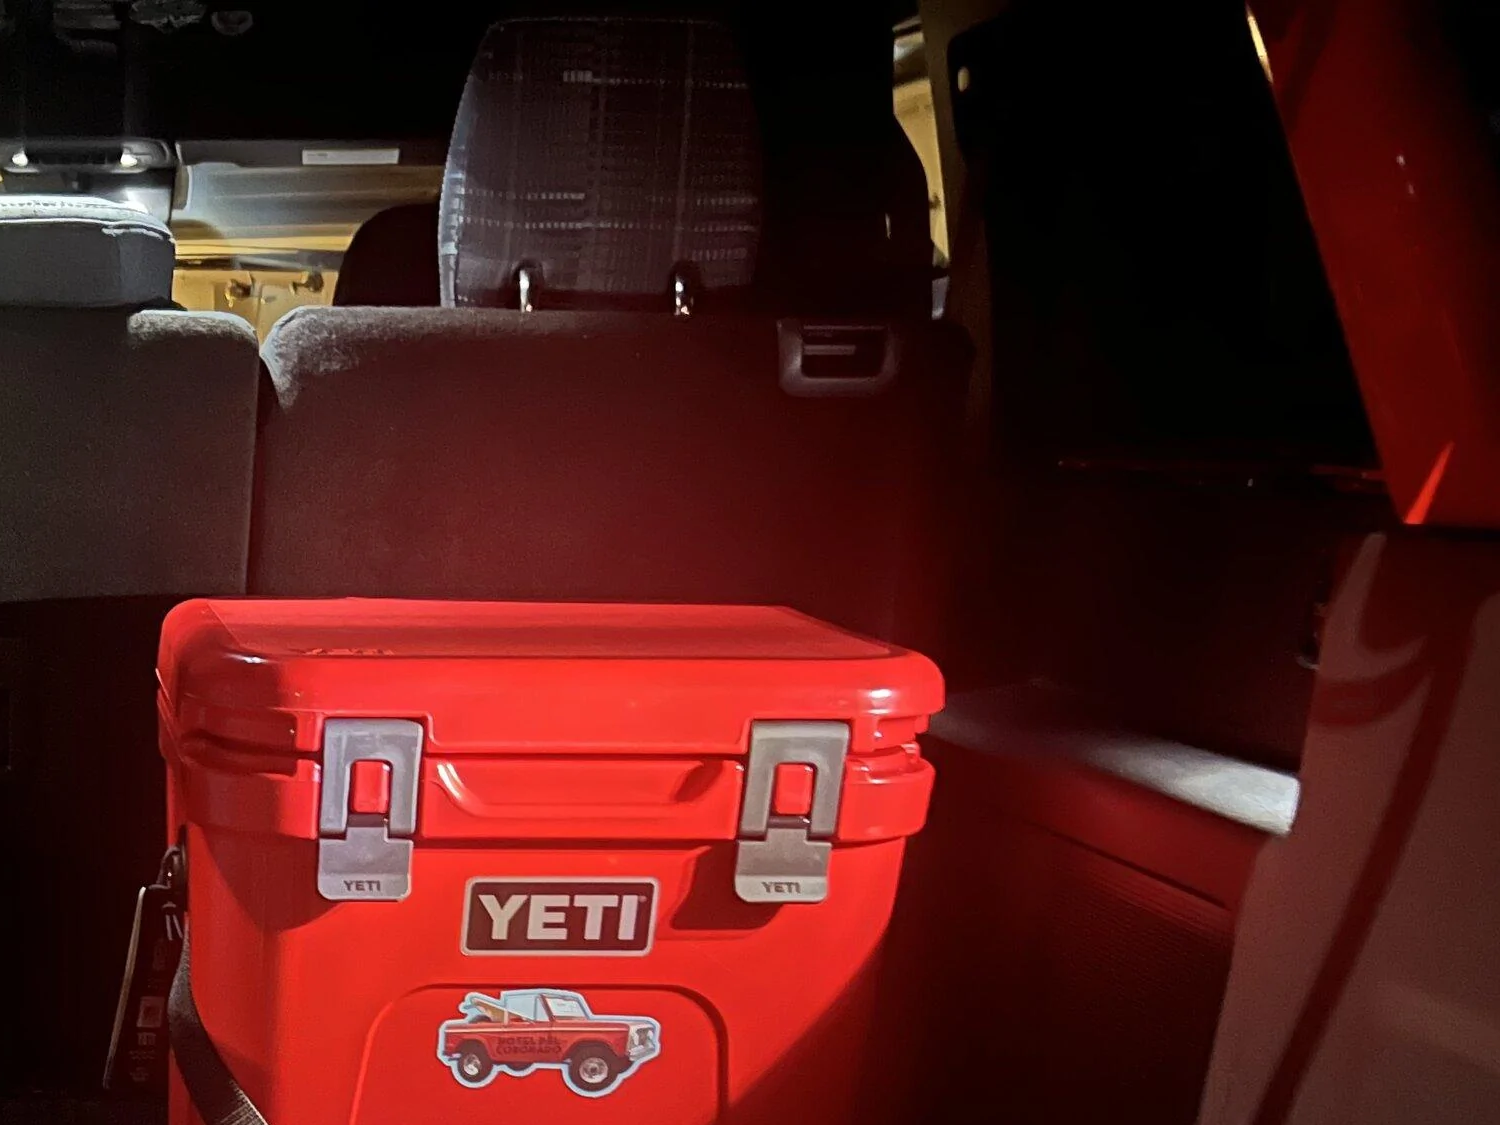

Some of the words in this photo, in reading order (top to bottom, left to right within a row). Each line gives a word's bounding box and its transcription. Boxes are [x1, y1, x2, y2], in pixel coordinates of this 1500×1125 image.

[343, 880, 381, 892] YETI
[761, 881, 801, 893] YETI
[477, 894, 639, 940] YETI
